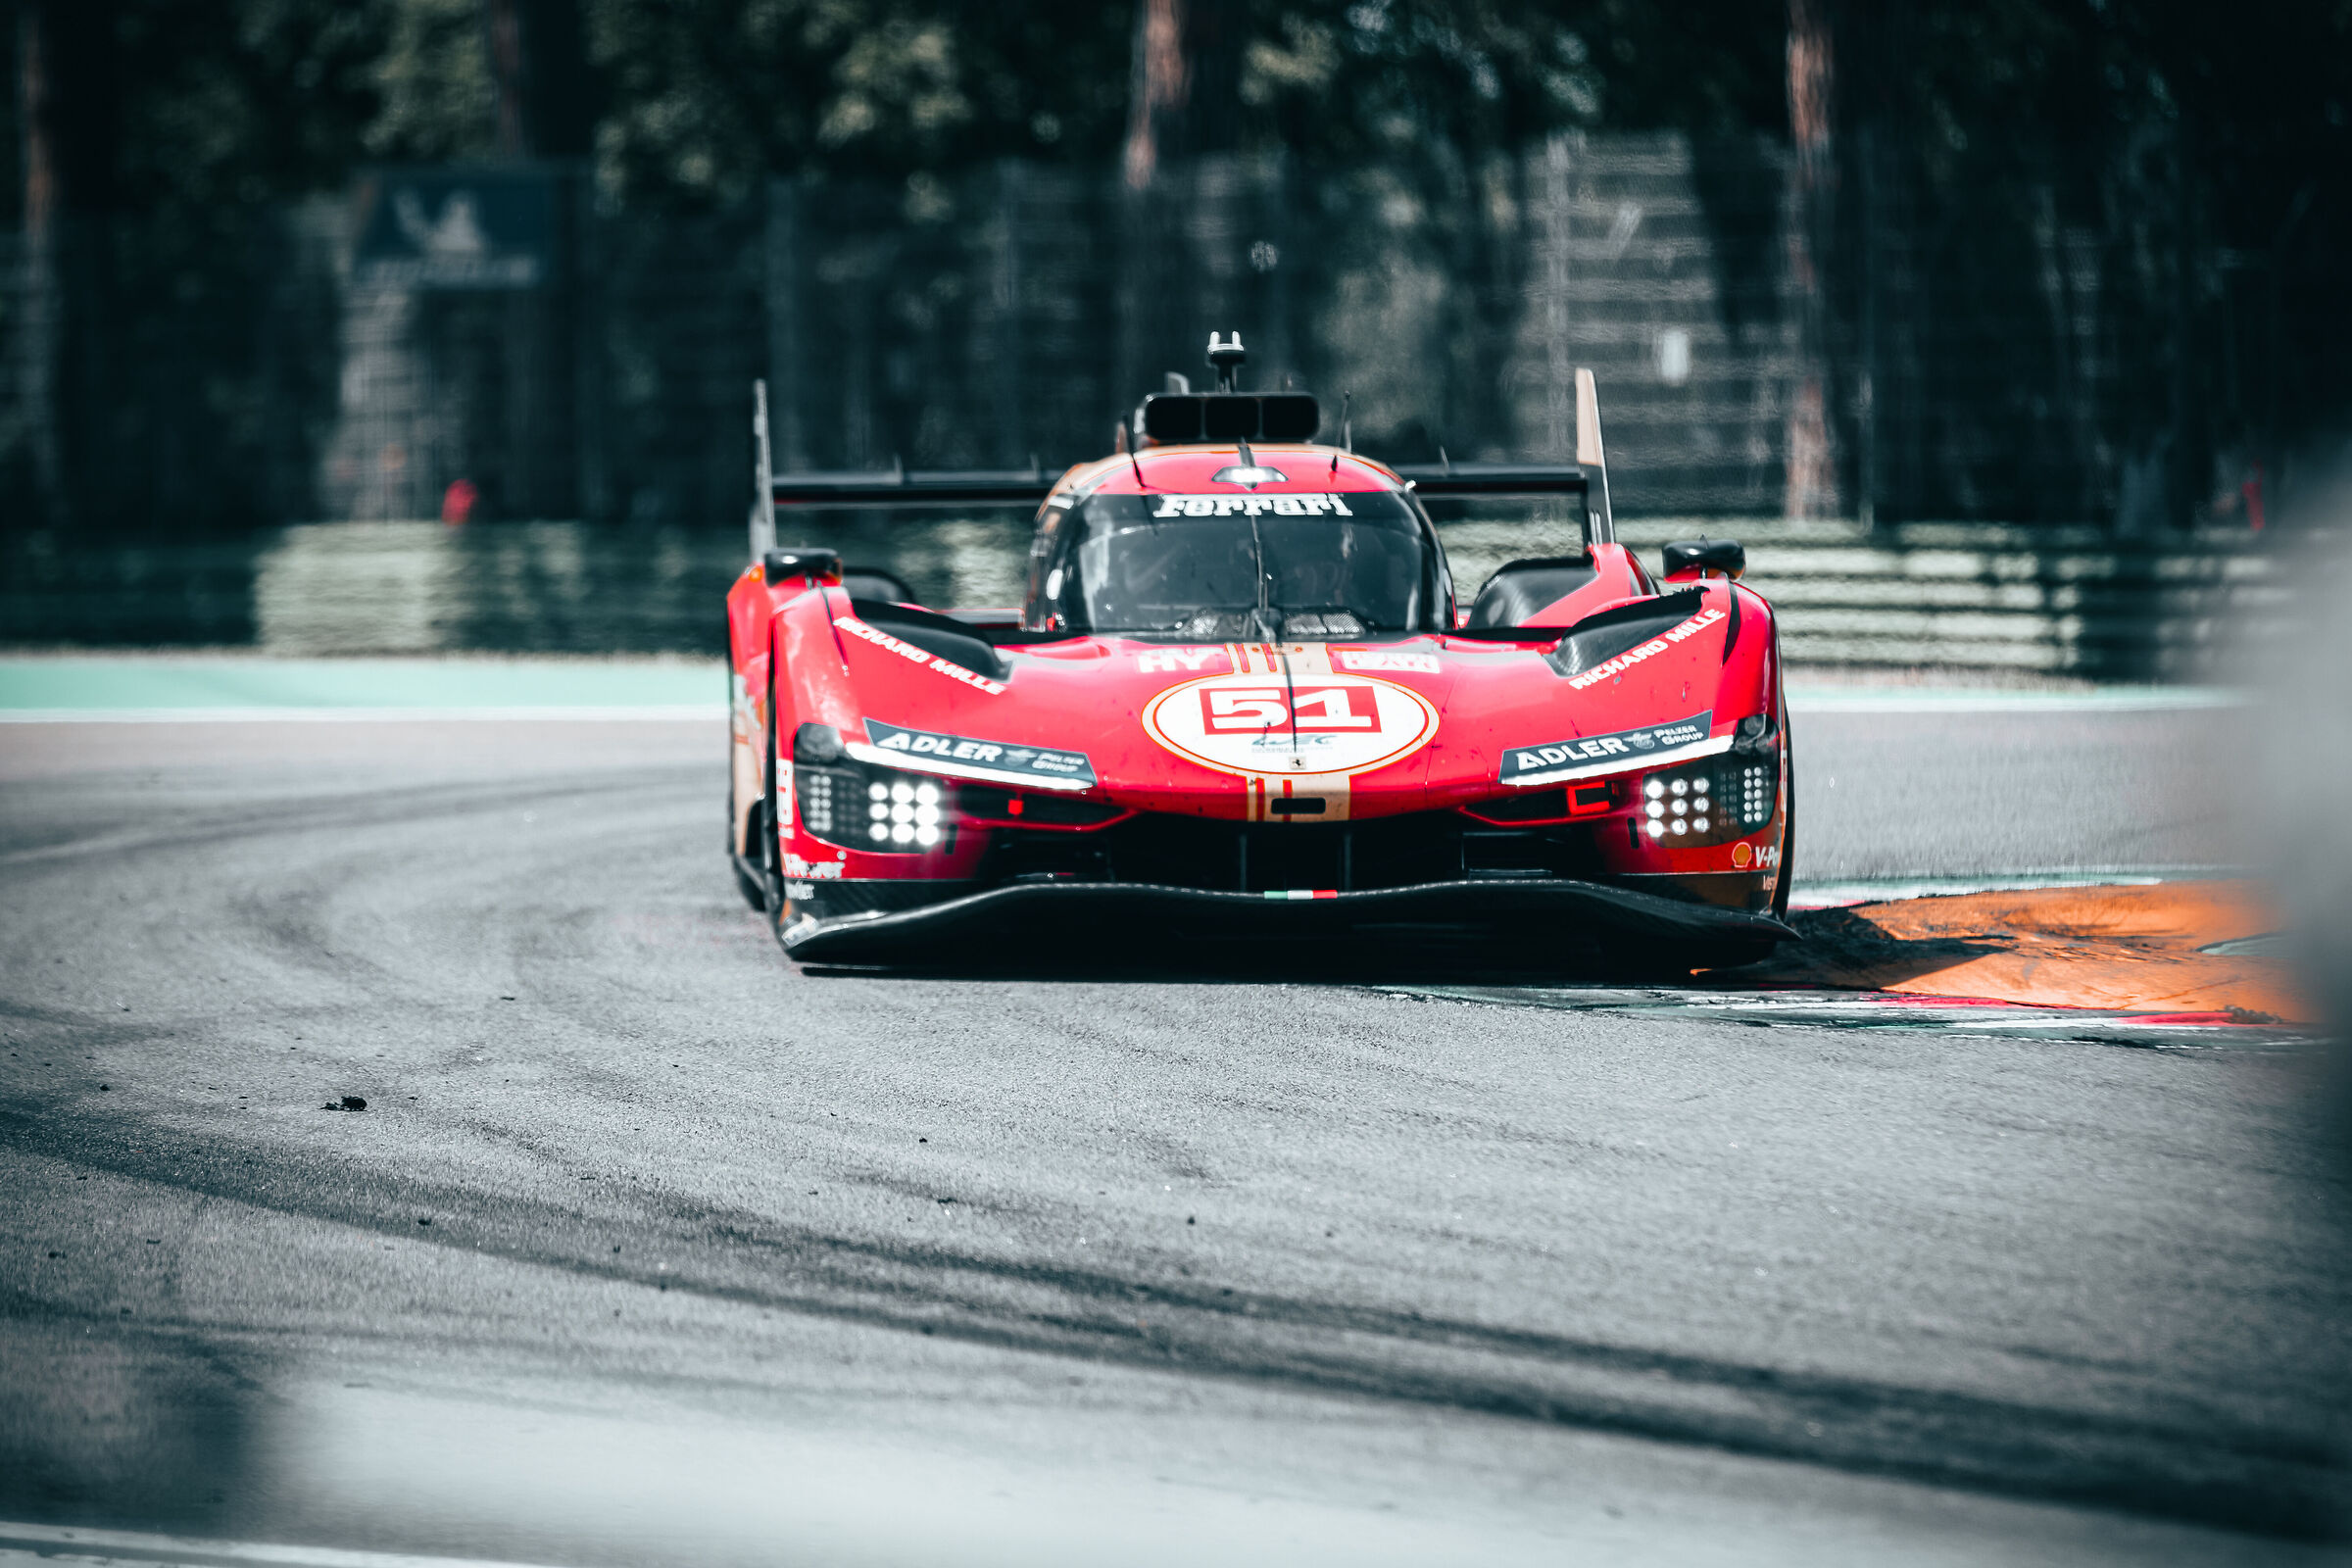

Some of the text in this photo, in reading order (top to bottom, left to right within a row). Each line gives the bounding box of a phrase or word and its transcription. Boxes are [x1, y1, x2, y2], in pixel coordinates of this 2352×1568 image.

[1153, 493, 1353, 517] Ferrari
[1568, 609, 1725, 690] RICHARD MILLE
[929, 660, 1006, 695] MILLE
[1209, 689, 1372, 729] 51
[877, 732, 1003, 762] ADLER
[1517, 737, 1630, 770] ADLER
